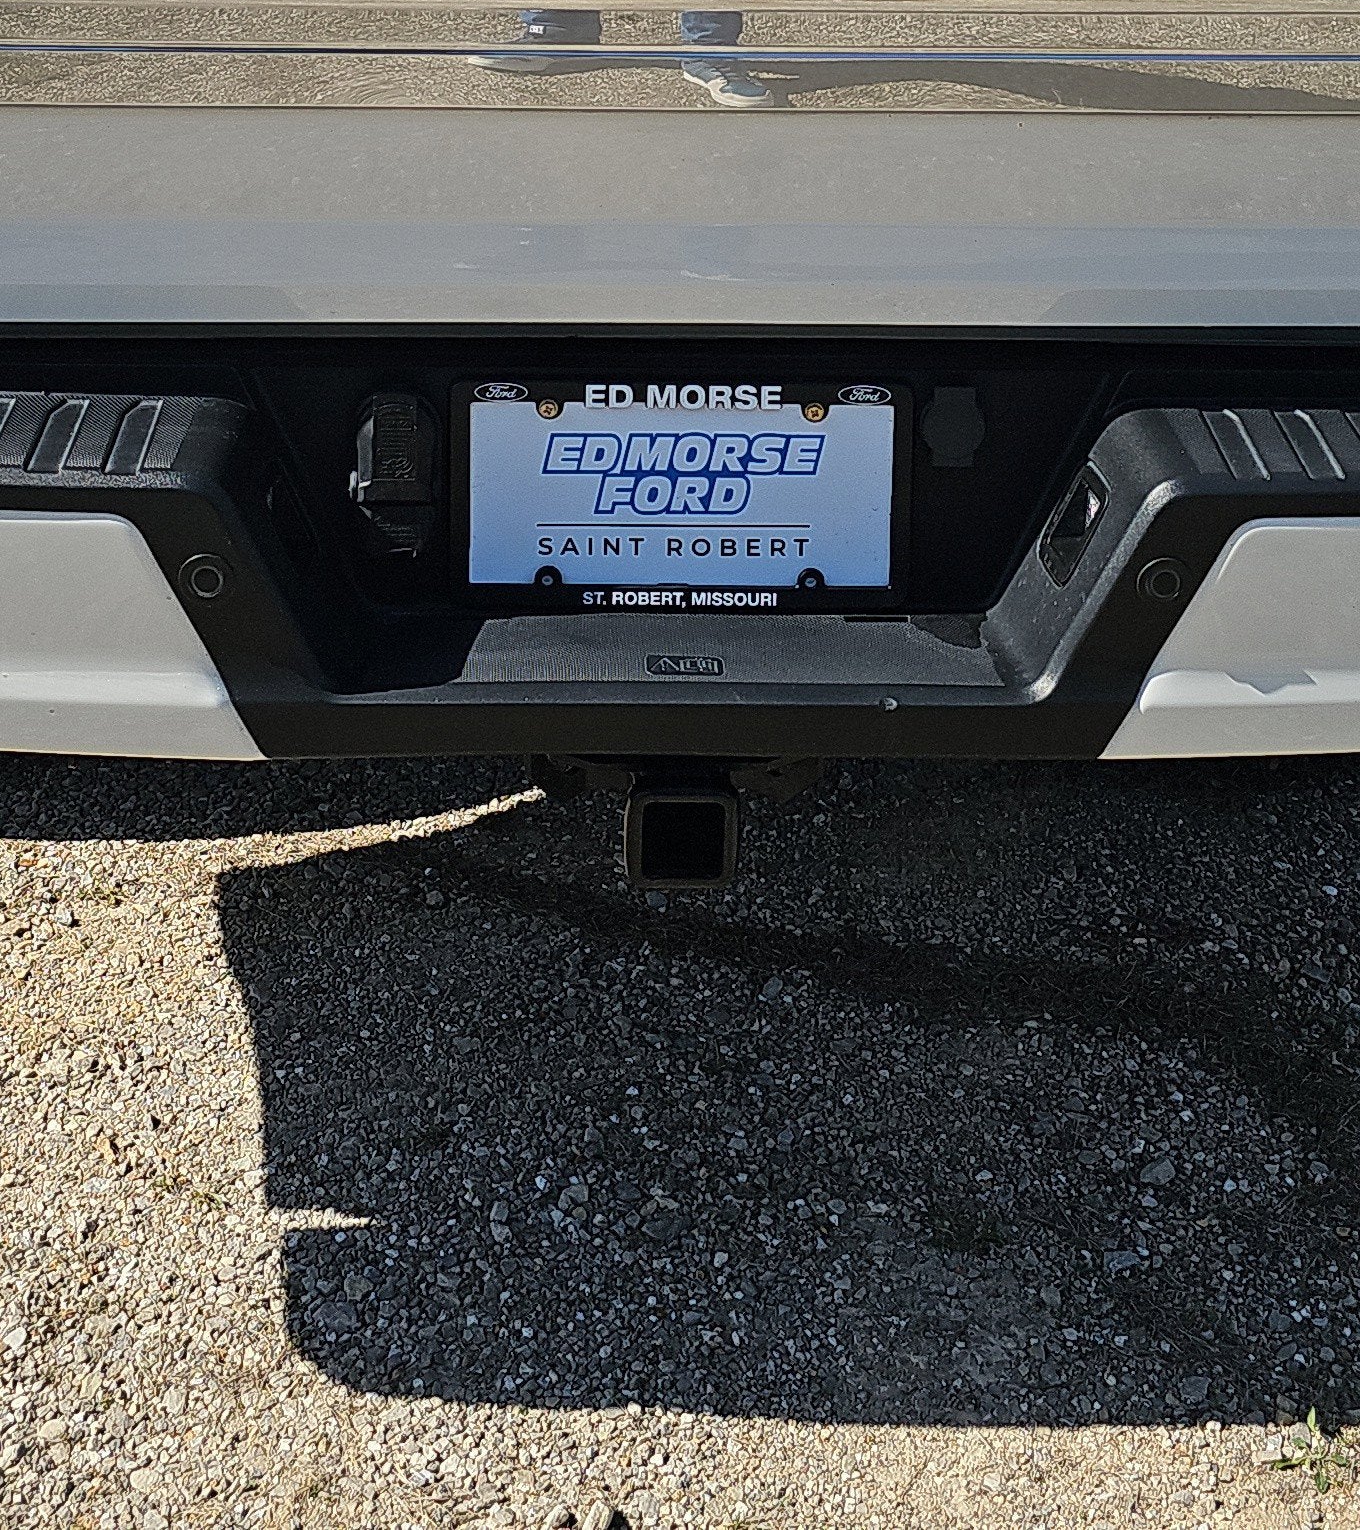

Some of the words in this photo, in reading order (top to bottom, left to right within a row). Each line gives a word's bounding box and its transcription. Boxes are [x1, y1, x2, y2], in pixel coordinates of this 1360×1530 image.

[584, 384, 634, 410] ED
[646, 384, 783, 411] MORSE
[542, 433, 622, 475] ED
[621, 432, 826, 476] MORSE
[594, 473, 752, 515] FORD
[537, 537, 646, 557] SAINT
[667, 538, 811, 558] ROBERT
[582, 591, 607, 606] ST.
[611, 592, 687, 608] ROBERT,
[691, 593, 777, 607] MISSOURI
